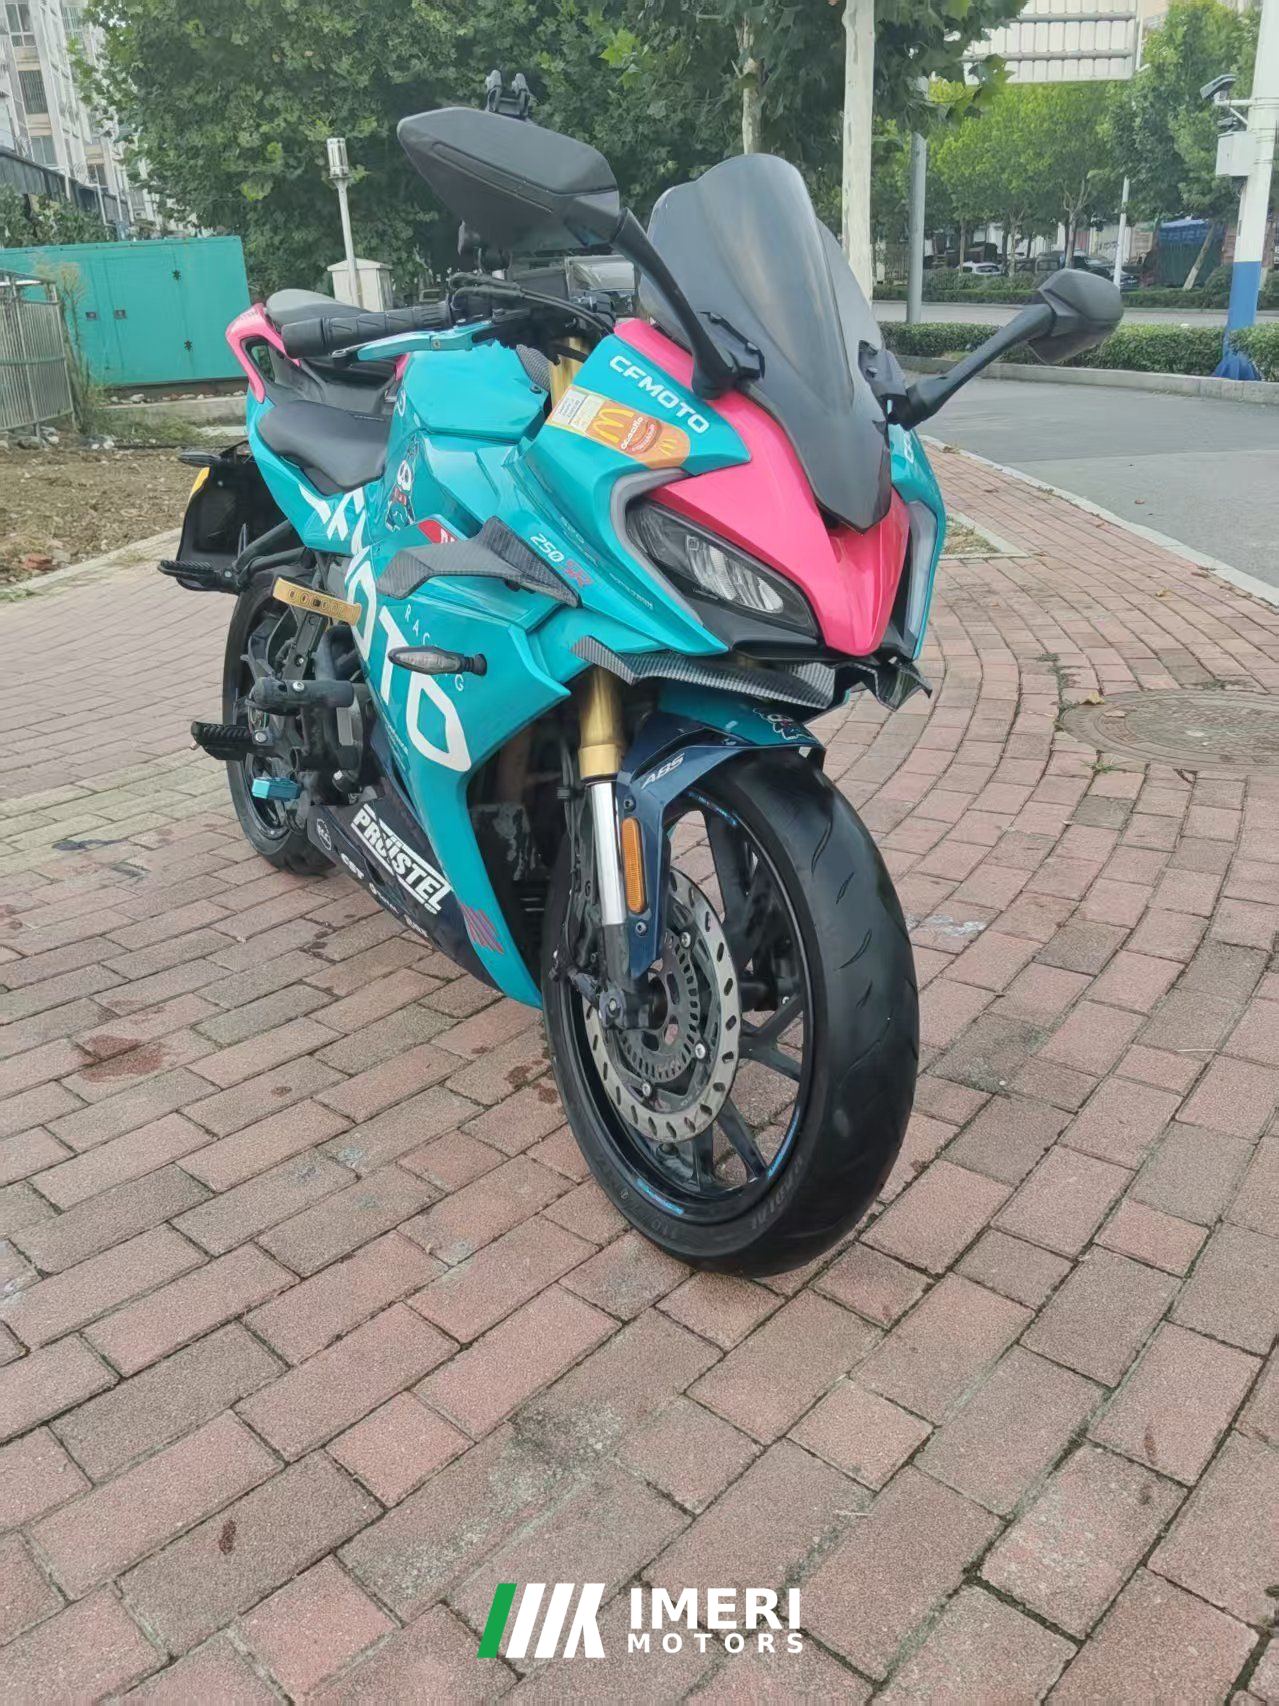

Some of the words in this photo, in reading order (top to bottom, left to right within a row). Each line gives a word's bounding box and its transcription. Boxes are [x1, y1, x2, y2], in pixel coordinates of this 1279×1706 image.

[609, 355, 709, 434] CFMOTO
[530, 532, 565, 562] 250
[404, 604, 465, 692] RACG
[641, 752, 686, 789] ABS
